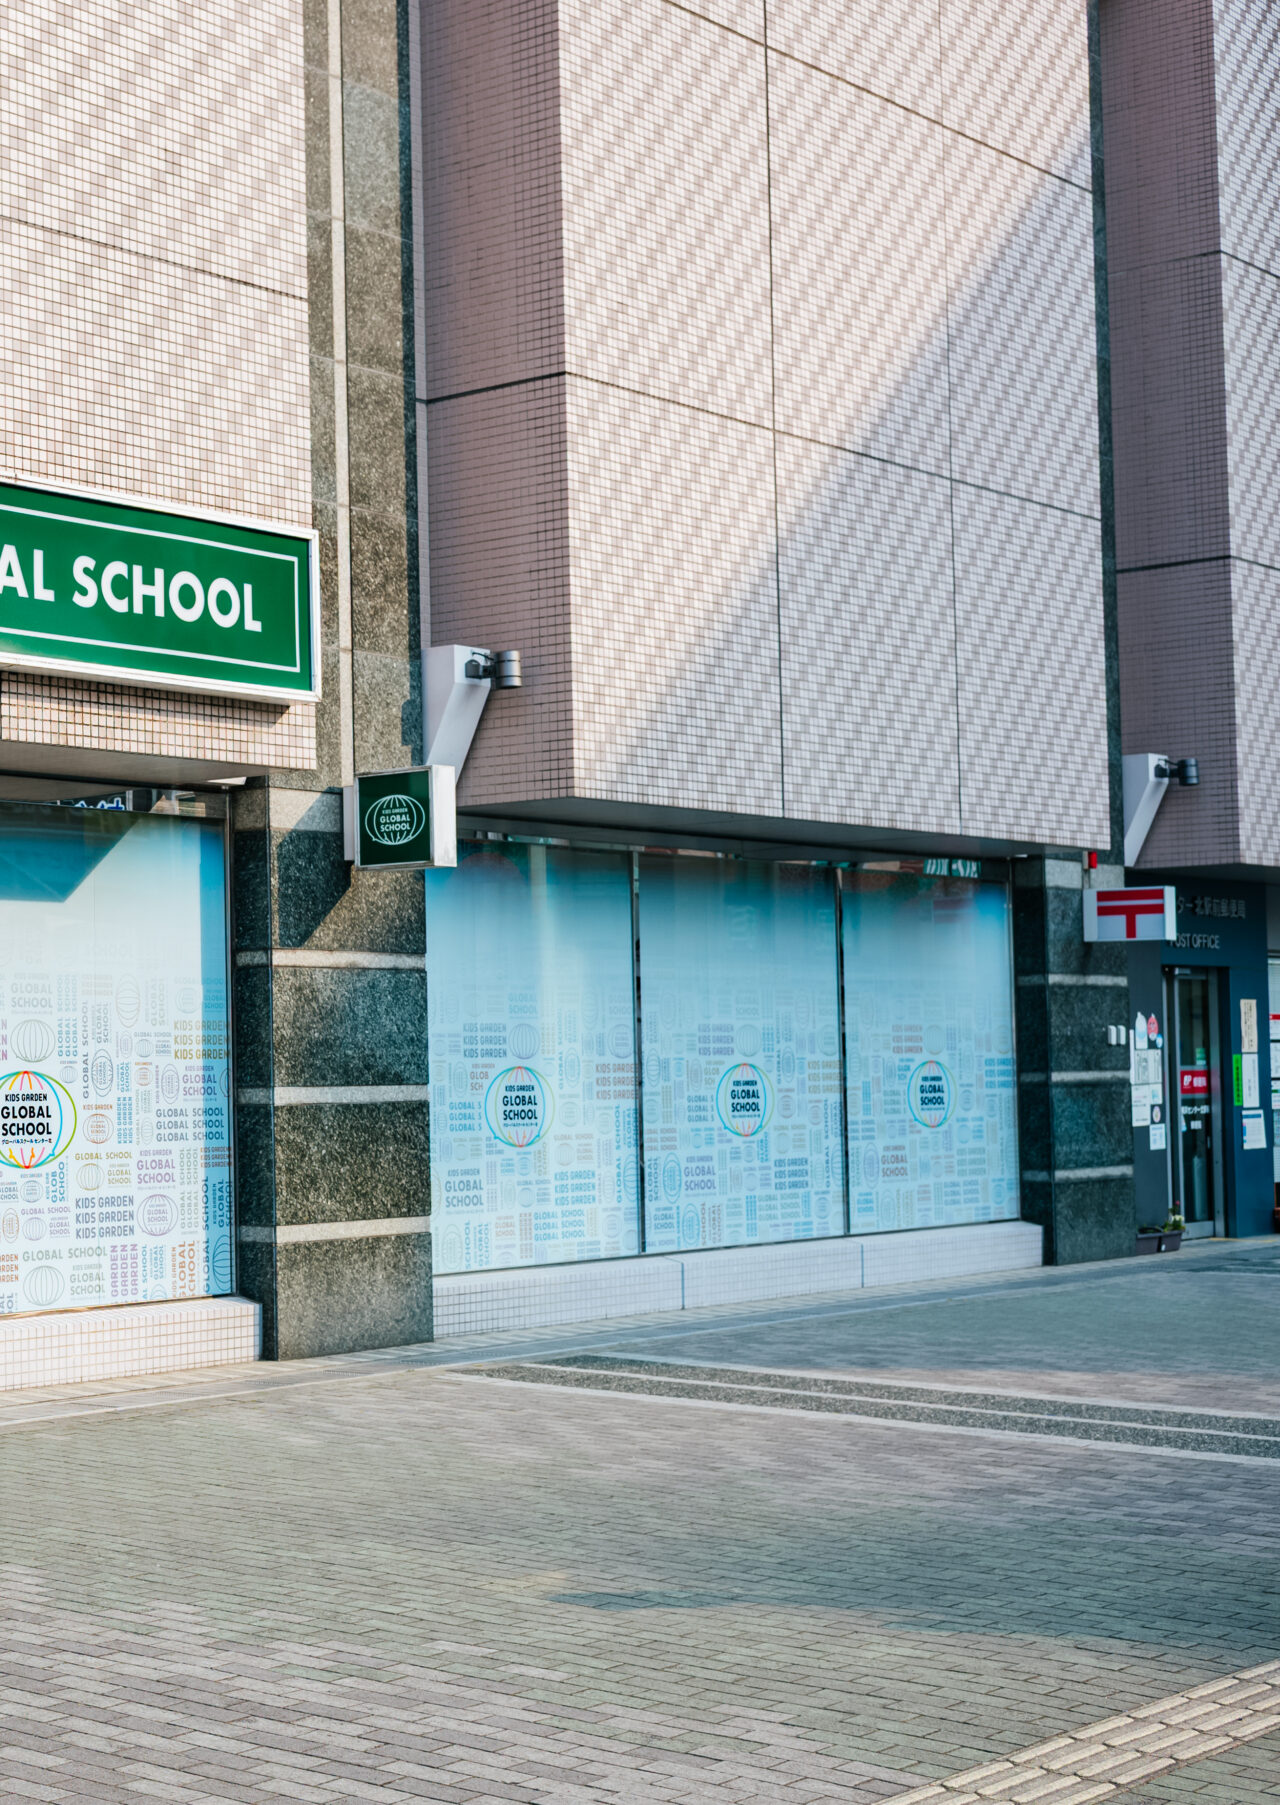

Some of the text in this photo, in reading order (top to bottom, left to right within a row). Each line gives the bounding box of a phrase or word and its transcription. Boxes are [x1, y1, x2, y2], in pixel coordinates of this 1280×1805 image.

[72, 556, 262, 633] SCHOOL
[380, 814, 410, 823] GLOBAL
[380, 823, 411, 832] SCHOOL
[1192, 934, 1220, 949] OFFICE
[11, 983, 53, 994] GLOBAL
[11, 997, 53, 1008] SCHOOL
[183, 1074, 216, 1084] GLOBAL
[183, 1086, 217, 1096] SCHOOL
[731, 1089, 759, 1099] GLOBAL
[920, 1085, 944, 1094] GLOBAL
[5, 1093, 47, 1102] KIDS GARDEN
[503, 1095, 537, 1106] GLOBAL
[920, 1096, 944, 1105] SCHOOL
[1, 1106, 51, 1119] GLOBAL
[731, 1102, 760, 1112] SCHOOL
[156, 1108, 224, 1118] GLOBAL SCHOOL
[504, 1109, 537, 1120] SCHOOL
[2, 1122, 52, 1136] SCHOOL
[156, 1119, 224, 1130] GLOBAL SCHOOL
[156, 1131, 224, 1142] GLOBAL SCHOOL
[75, 1152, 102, 1160] GLOBAL
[881, 1154, 908, 1164] GLOBAL
[137, 1160, 175, 1170] GLOBAL
[684, 1166, 716, 1177] GLOBAL
[882, 1167, 908, 1177] SCHOOL
[138, 1172, 176, 1184] SCHOOL
[445, 1180, 483, 1192] GLOBAL
[685, 1179, 716, 1190] SCHOOL
[76, 1195, 134, 1209] KIDS GARDEN
[446, 1195, 483, 1207] SCHOOL
[76, 1210, 134, 1224] KIDS GARDEN
[76, 1225, 134, 1239] KIDS GARDEN
[23, 1246, 107, 1262] GLOBAL SCHOOL
[110, 1245, 118, 1297] GARDEN
[120, 1244, 128, 1296] GARDEN
[130, 1244, 138, 1296] GARDEN
